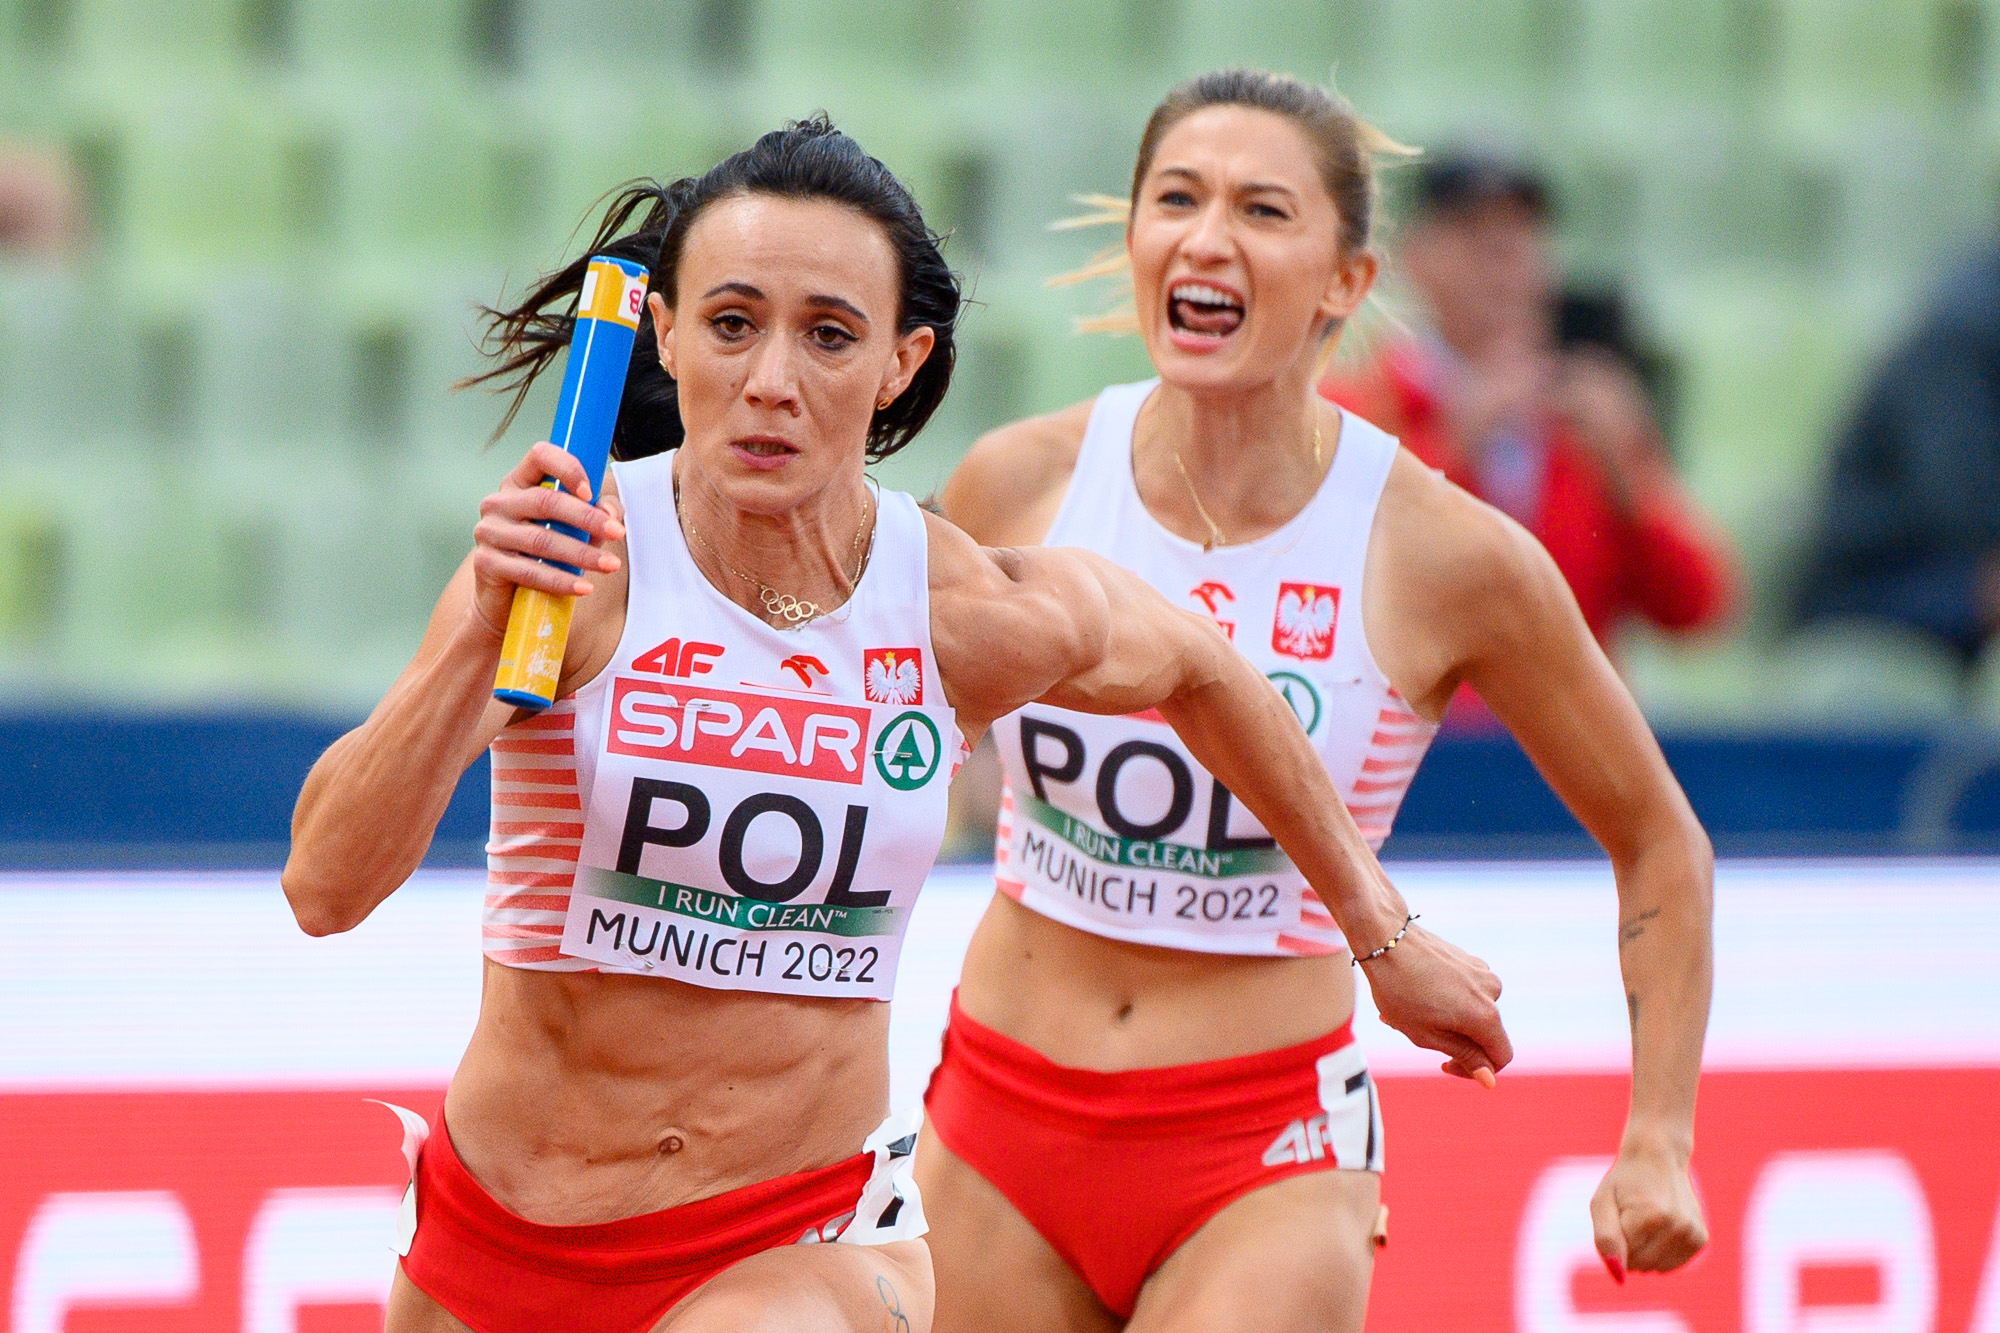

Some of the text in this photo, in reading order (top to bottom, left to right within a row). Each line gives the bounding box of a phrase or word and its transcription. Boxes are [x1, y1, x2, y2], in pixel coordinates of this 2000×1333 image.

[615, 690, 863, 773] SPAR
[1020, 715, 1278, 852] POL
[615, 776, 893, 908] POL
[1021, 832, 1281, 923] MUNICH 2022
[1063, 816, 1073, 836] I
[1076, 821, 1121, 862] RUN
[657, 884, 667, 906] I
[675, 889, 741, 924] RUN
[585, 908, 880, 984] MUNICH 2022
